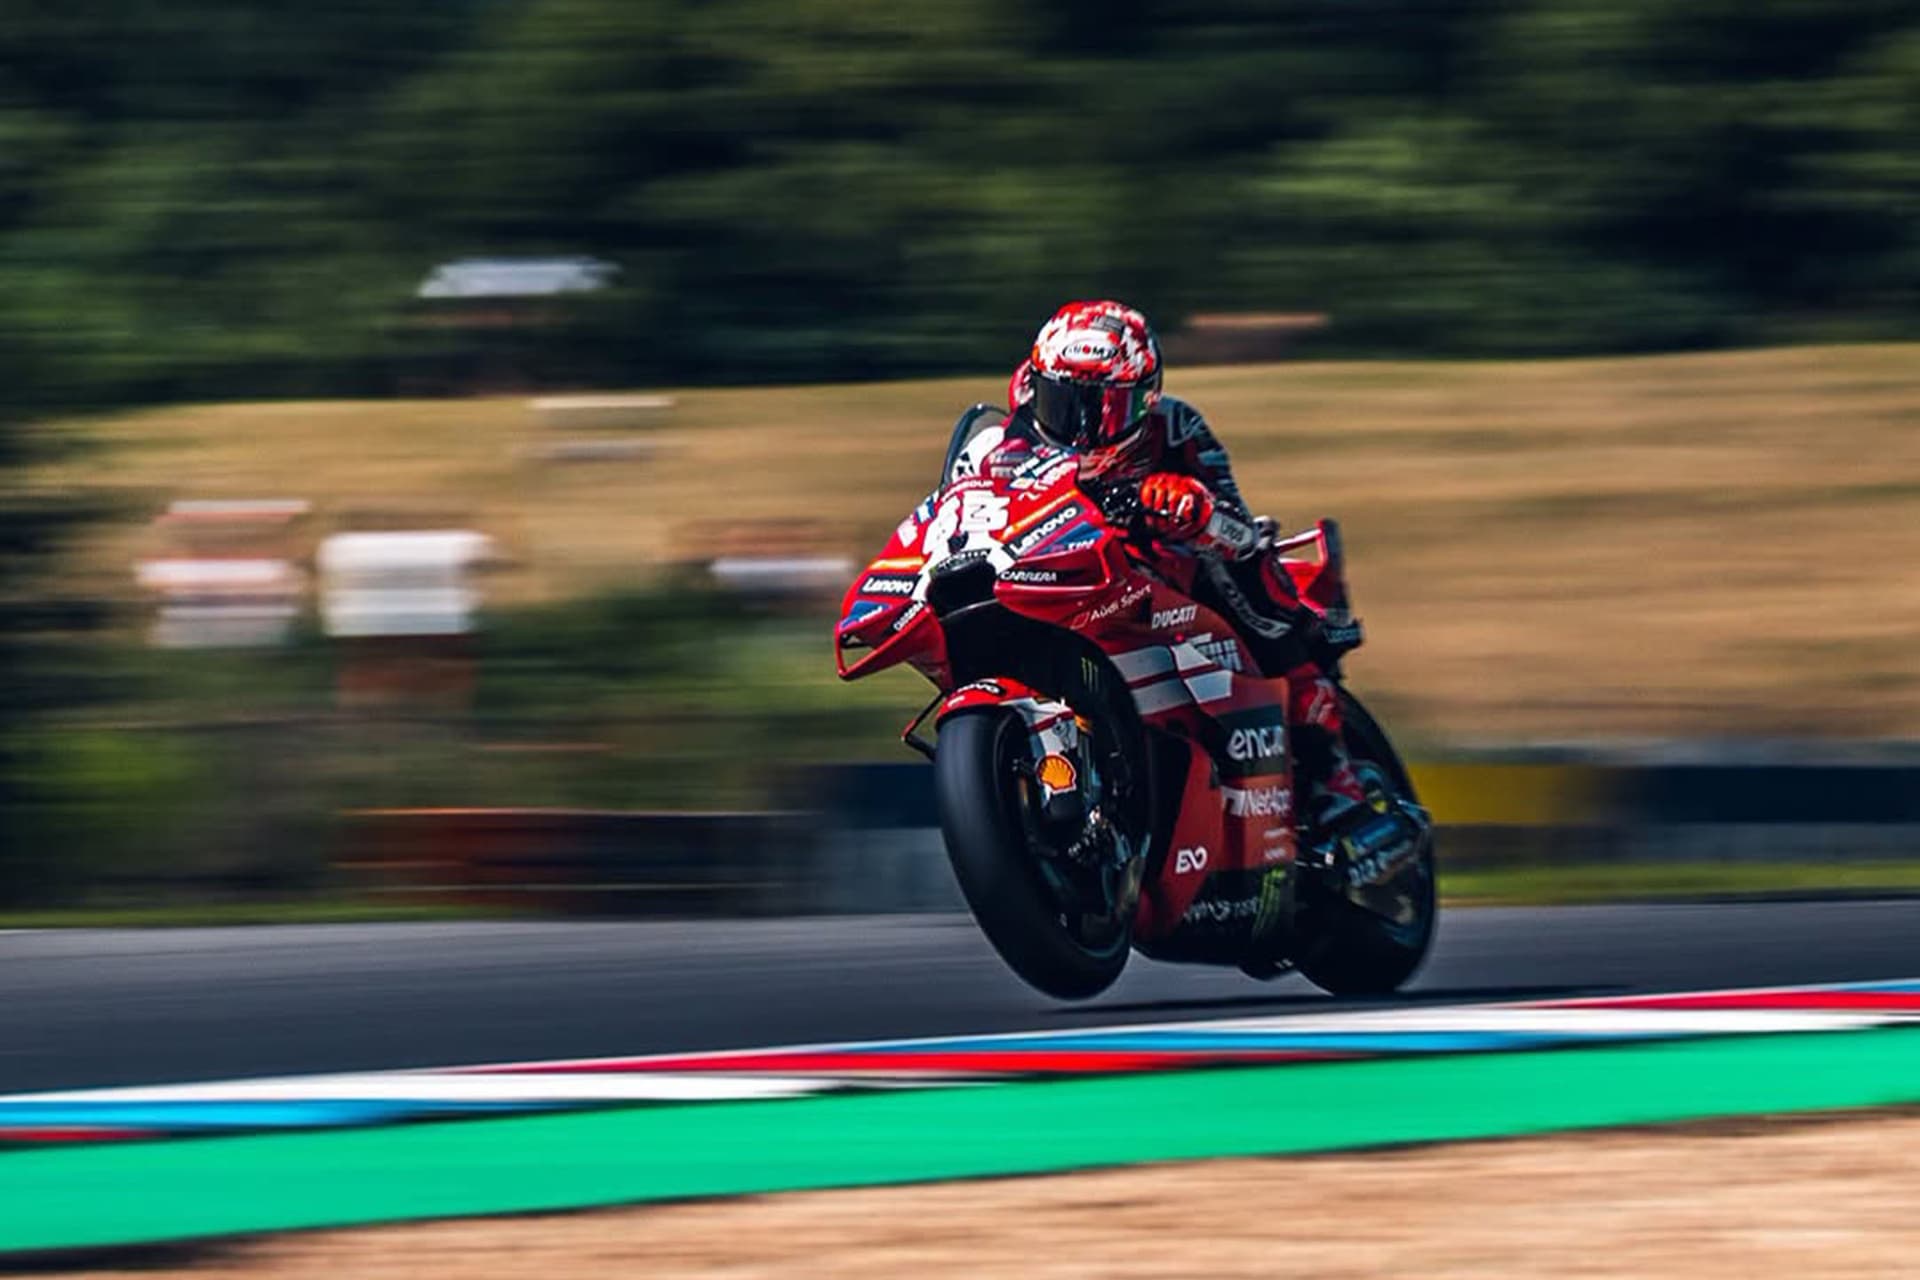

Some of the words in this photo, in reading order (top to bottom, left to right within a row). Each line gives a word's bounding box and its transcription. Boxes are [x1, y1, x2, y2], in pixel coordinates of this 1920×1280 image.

[1010, 506, 1078, 554] Lenovo
[862, 577, 914, 593] Lenovo
[1001, 571, 1058, 582] CARRERA
[1090, 602, 1119, 621] Audi
[1121, 584, 1151, 608] Sport
[1152, 605, 1198, 629] DUCATI
